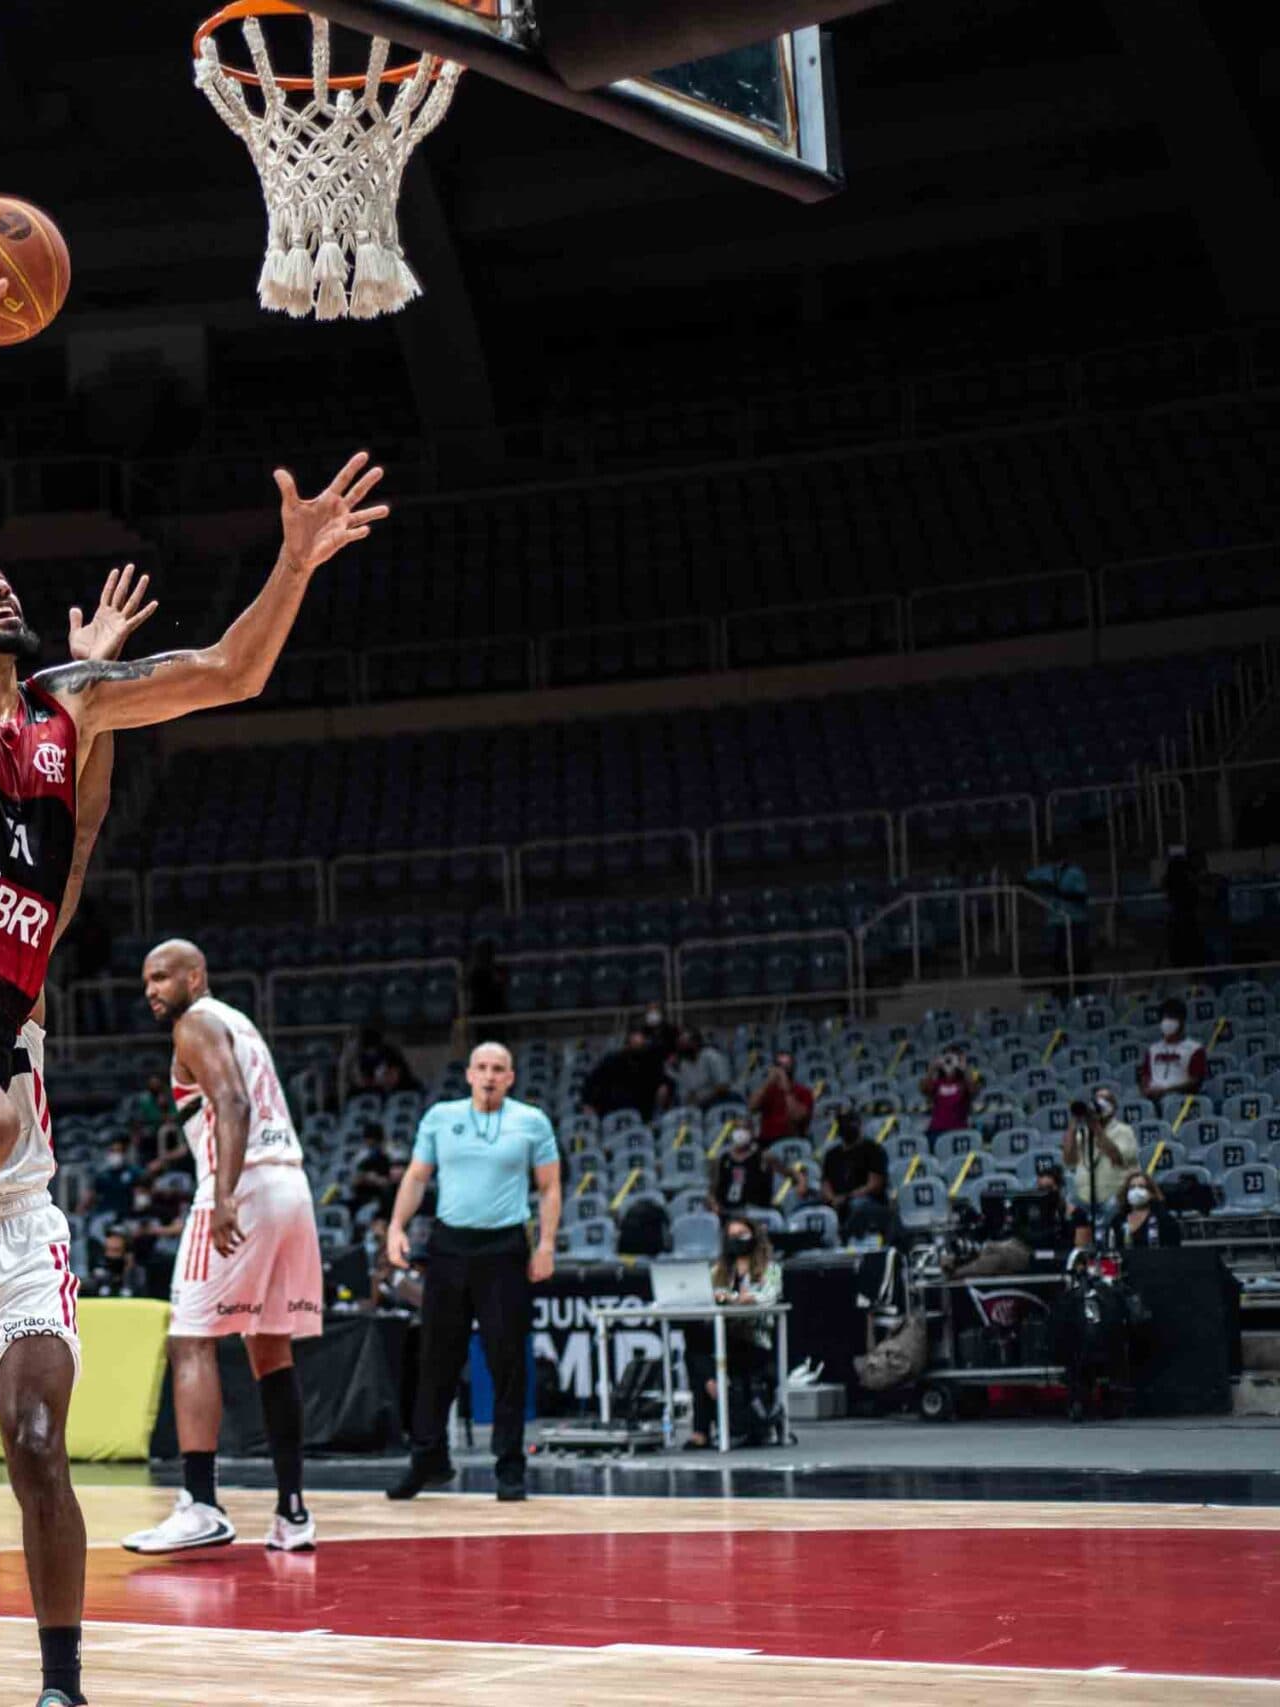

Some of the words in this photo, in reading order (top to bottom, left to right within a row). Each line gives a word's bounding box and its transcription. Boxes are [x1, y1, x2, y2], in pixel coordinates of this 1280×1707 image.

[1245, 1176, 1263, 1193] 23
[287, 1299, 322, 1314] betsu
[531, 1294, 655, 1328] JUNTO
[2, 1316, 46, 1332] Cartão
[47, 1317, 63, 1328] de
